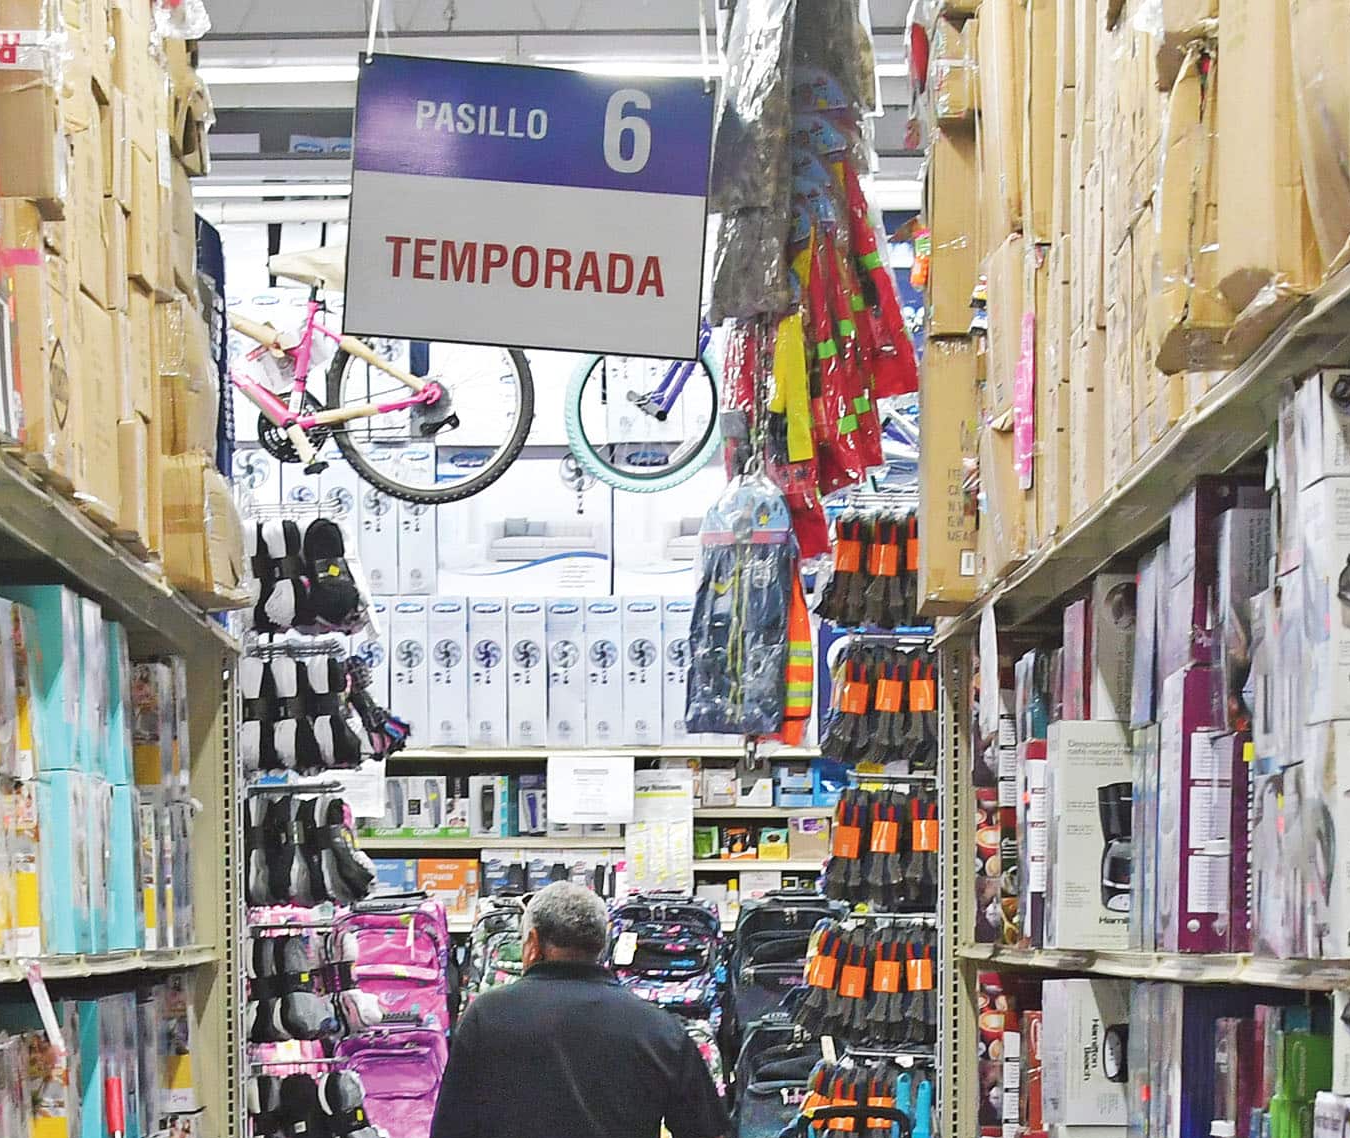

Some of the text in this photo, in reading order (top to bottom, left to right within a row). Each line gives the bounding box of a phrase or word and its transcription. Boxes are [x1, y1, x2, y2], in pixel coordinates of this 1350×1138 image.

[416, 88, 652, 174] PASILLO 6
[386, 235, 665, 298] TEMPORADA
[1091, 1018, 1100, 1069] Hamilton
